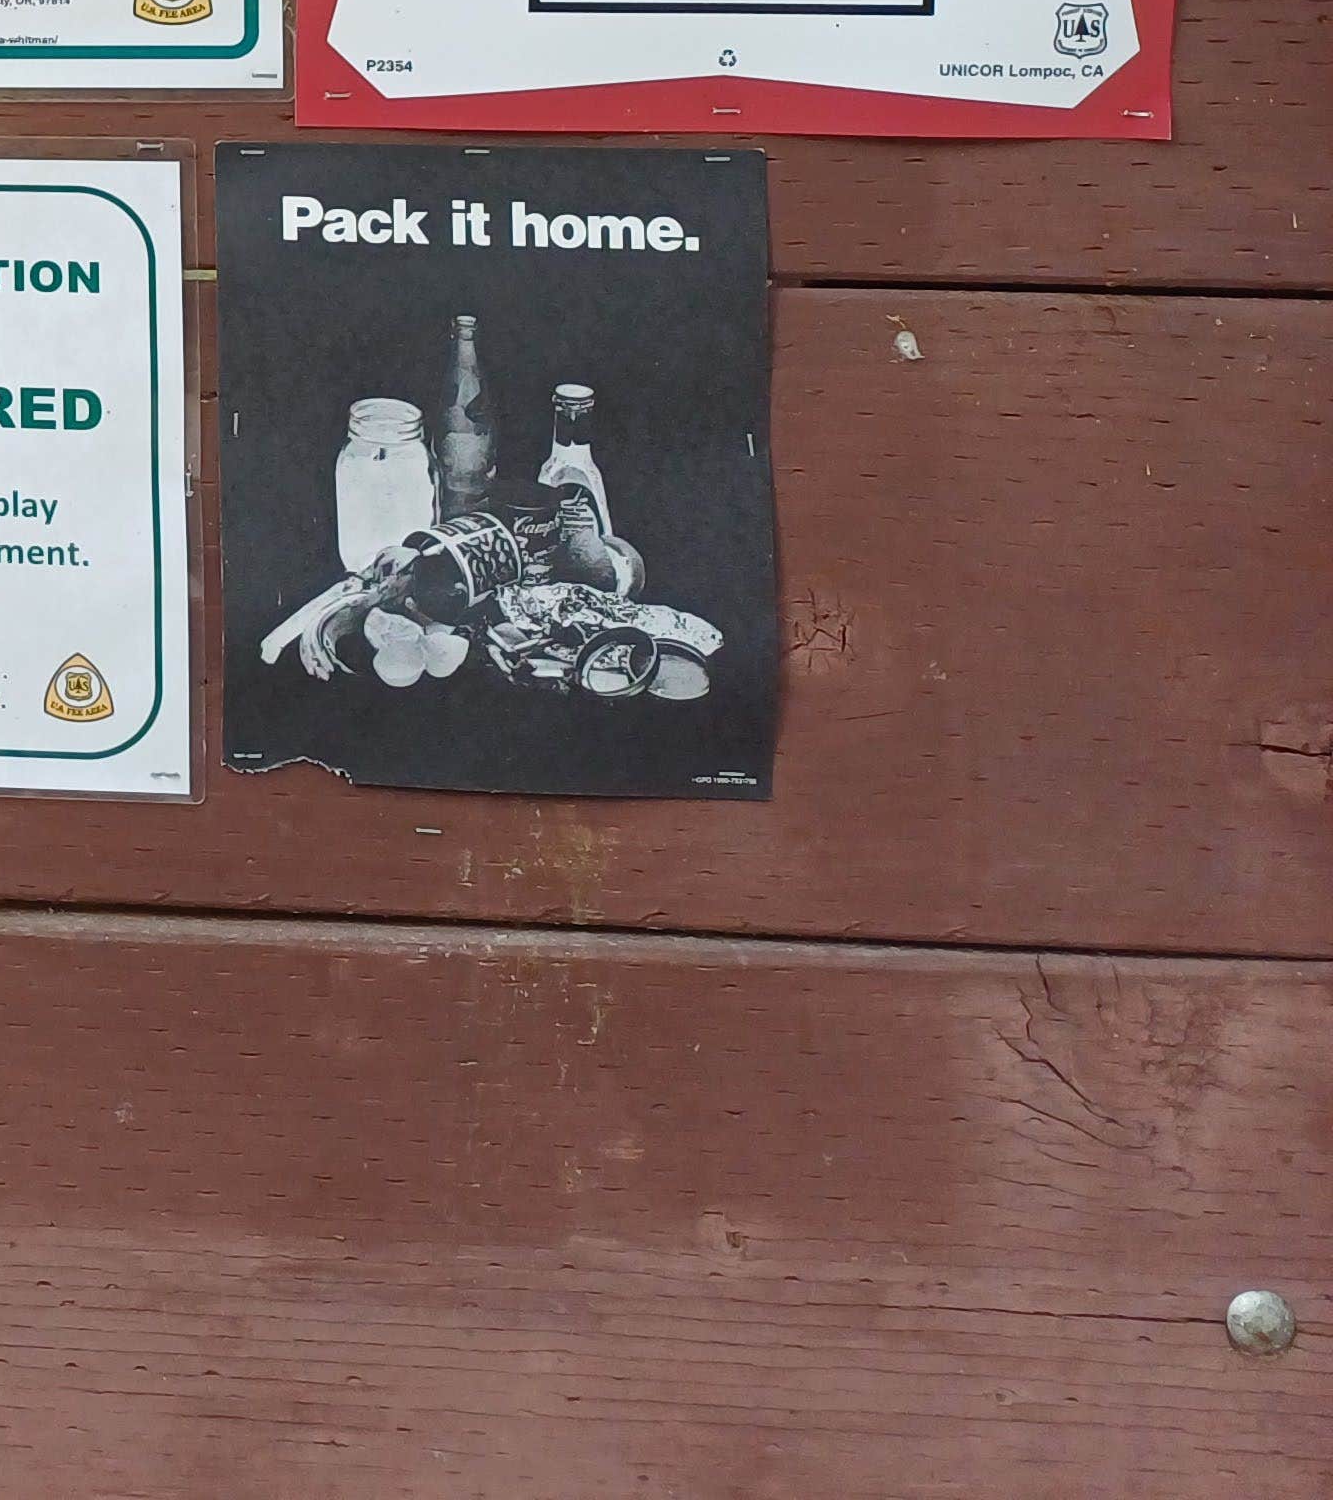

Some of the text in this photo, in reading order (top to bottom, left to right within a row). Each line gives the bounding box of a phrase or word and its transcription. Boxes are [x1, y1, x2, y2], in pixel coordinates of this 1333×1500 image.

[367, 60, 412, 72] P2354
[940, 64, 1103, 79] UNICOR Lompoc, CA
[283, 196, 699, 251] Pack it home.
